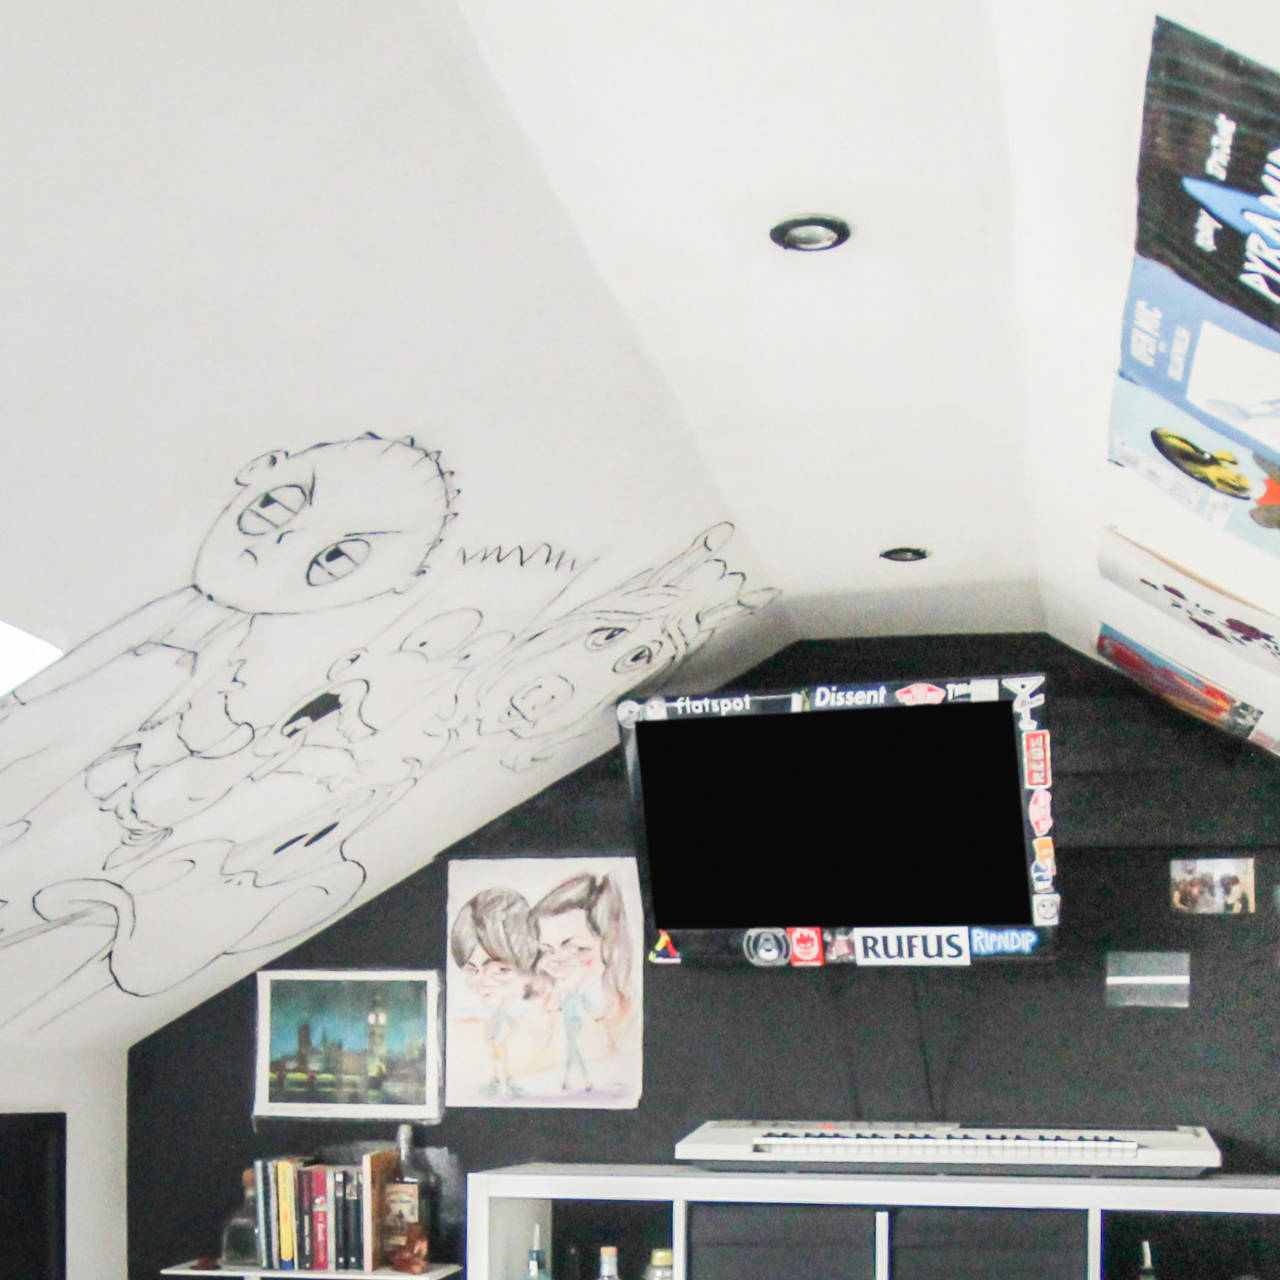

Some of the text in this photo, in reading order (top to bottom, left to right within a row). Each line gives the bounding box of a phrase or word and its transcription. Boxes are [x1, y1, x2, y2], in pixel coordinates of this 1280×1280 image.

[676, 695, 751, 716] flatspot
[815, 686, 887, 707] Dissent
[861, 934, 963, 959] RUFUS
[971, 929, 1036, 953] RIPNDIP
